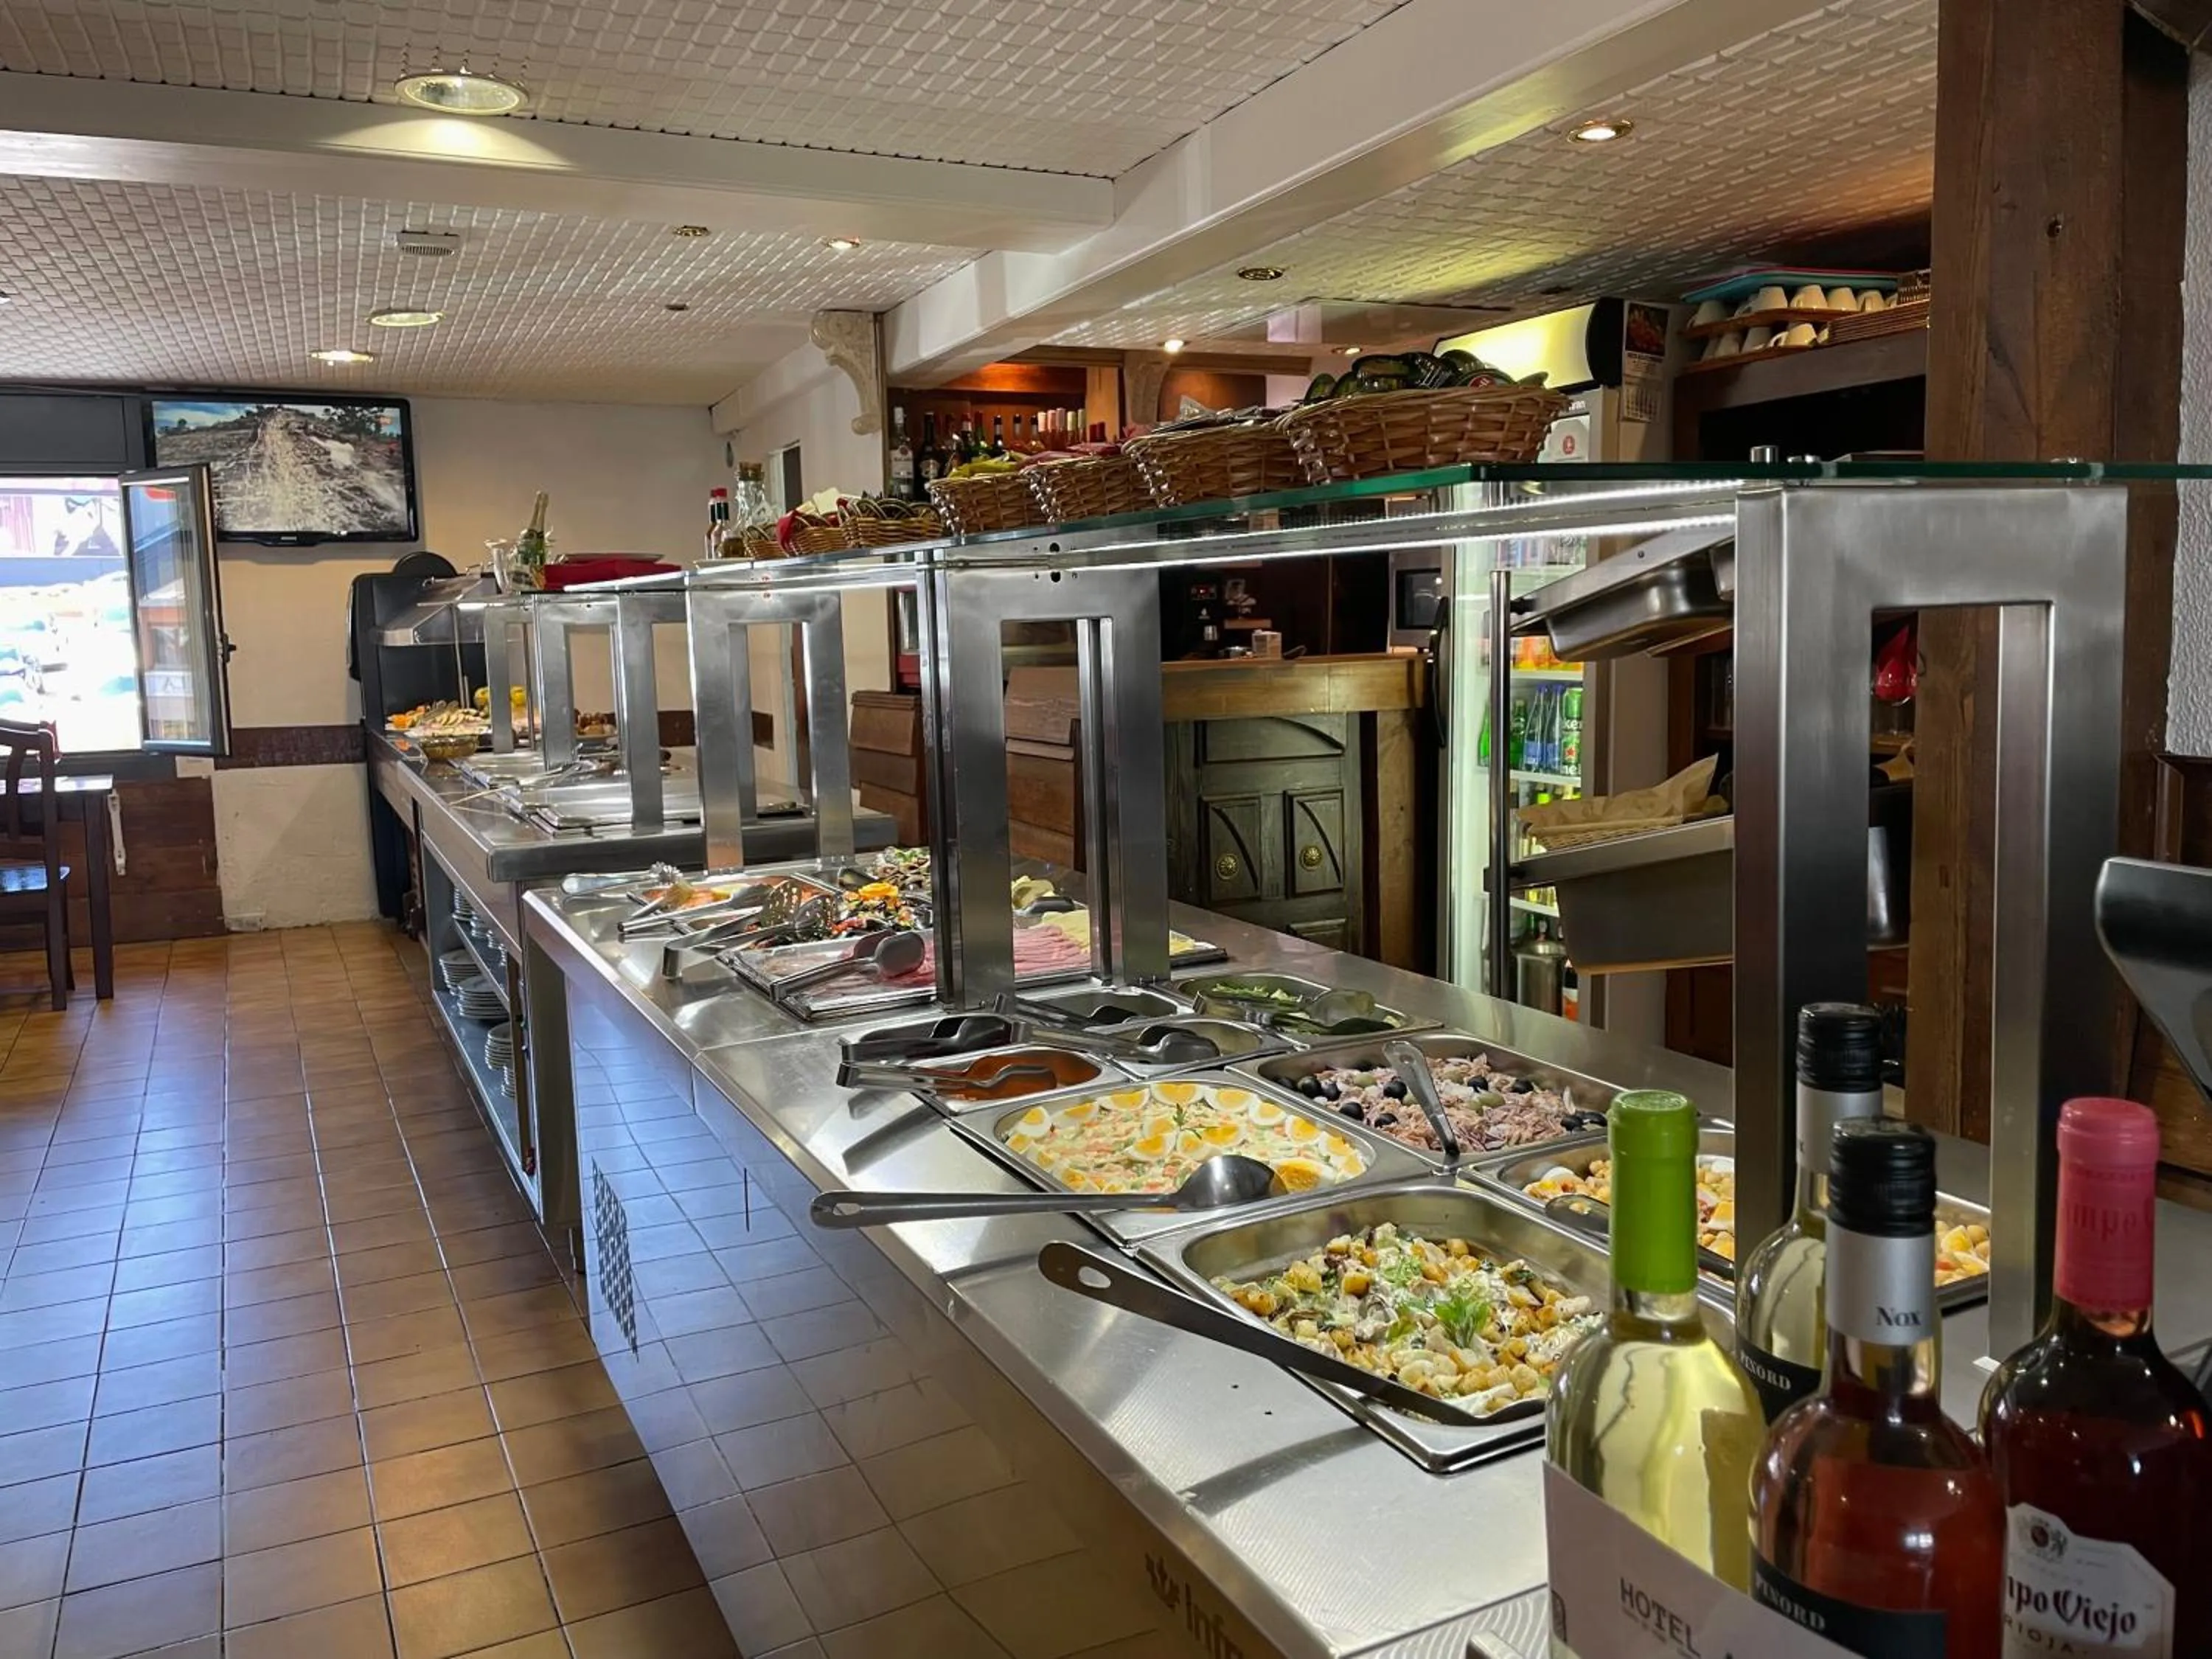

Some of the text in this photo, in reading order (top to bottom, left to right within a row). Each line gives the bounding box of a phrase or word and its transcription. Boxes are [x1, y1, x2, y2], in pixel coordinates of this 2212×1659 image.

[1877, 1306, 1923, 1327] Nox
[1620, 1577, 1702, 1658] HOTEL
[2053, 1590, 2137, 1642] Viejo
